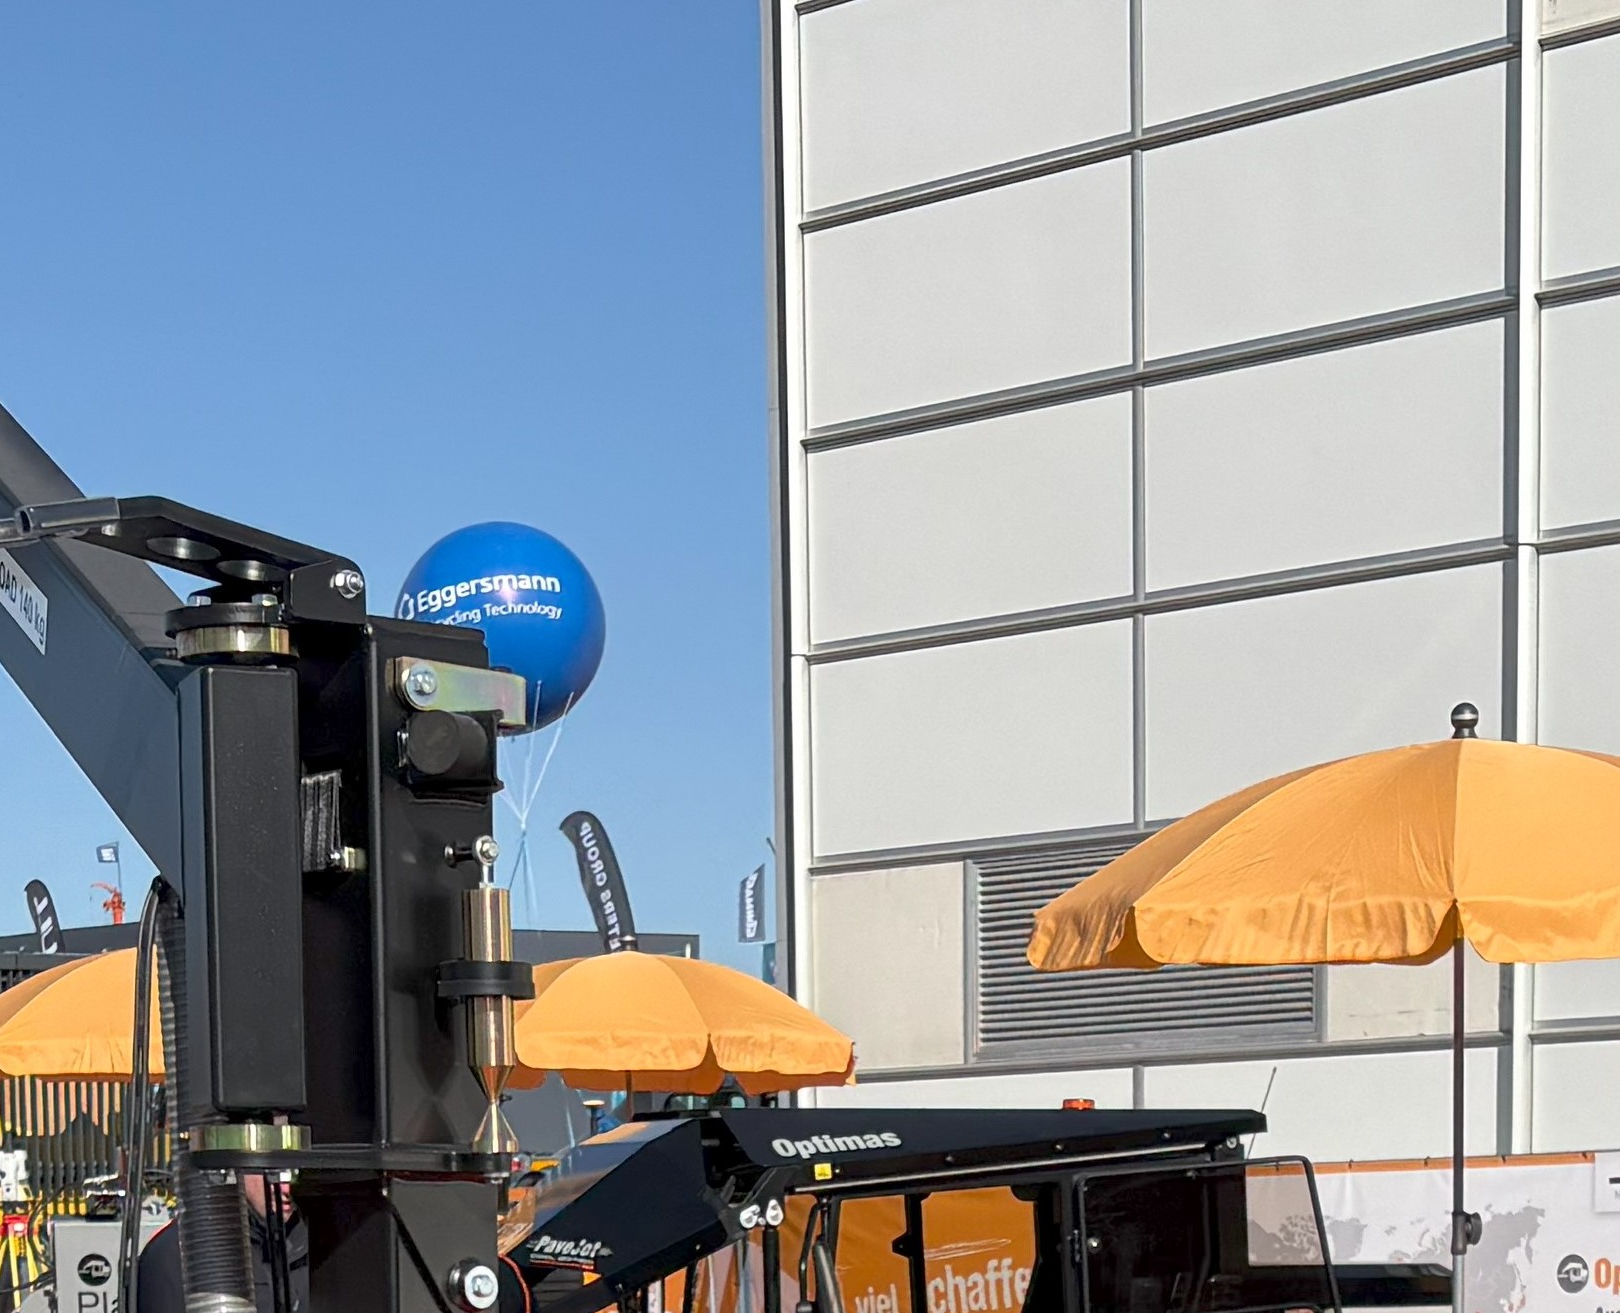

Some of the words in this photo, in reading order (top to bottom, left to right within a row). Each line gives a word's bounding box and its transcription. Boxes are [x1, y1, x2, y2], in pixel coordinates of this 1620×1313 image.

[416, 573, 561, 613] Eggersmann
[483, 601, 562, 620] Technology
[19, 585, 34, 624] 140
[33, 601, 45, 646] kg
[771, 1132, 902, 1159] Optimas
[1594, 1257, 1620, 1296] Op
